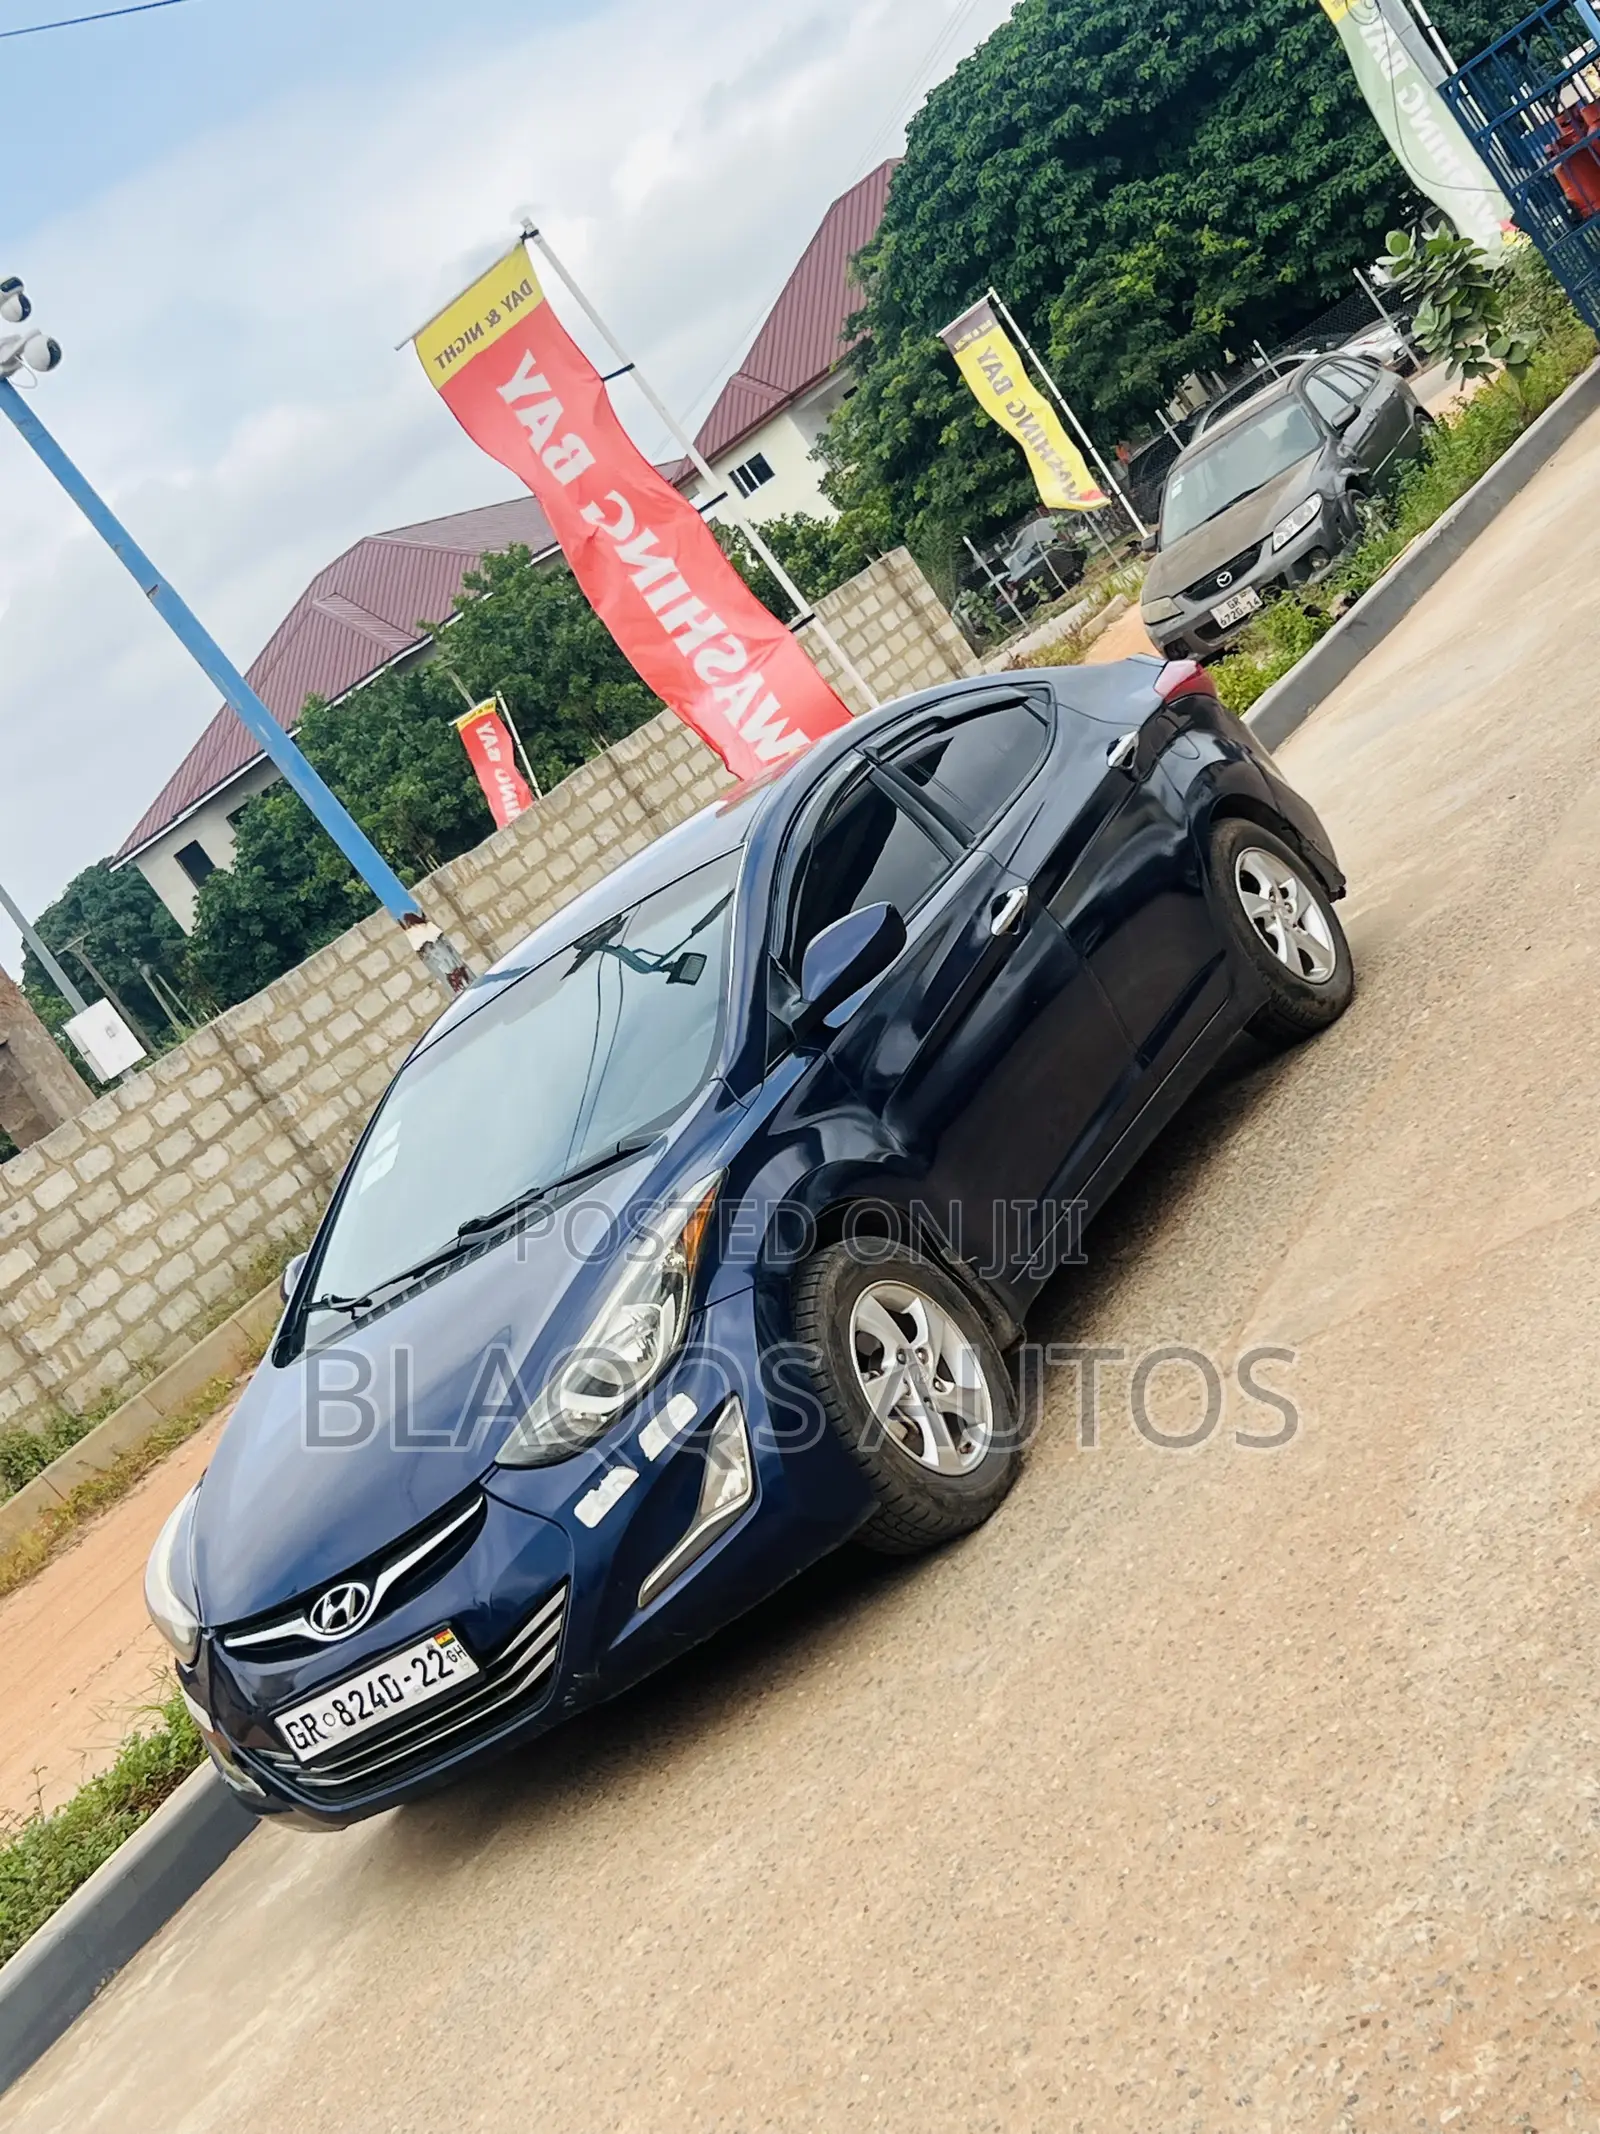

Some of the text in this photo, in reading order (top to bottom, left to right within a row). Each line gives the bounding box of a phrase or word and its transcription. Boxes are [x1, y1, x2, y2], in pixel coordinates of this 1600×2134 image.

[1227, 597, 1242, 609] GR
[447, 1645, 468, 1664] GH
[285, 1650, 453, 1750] GR 8240-22
